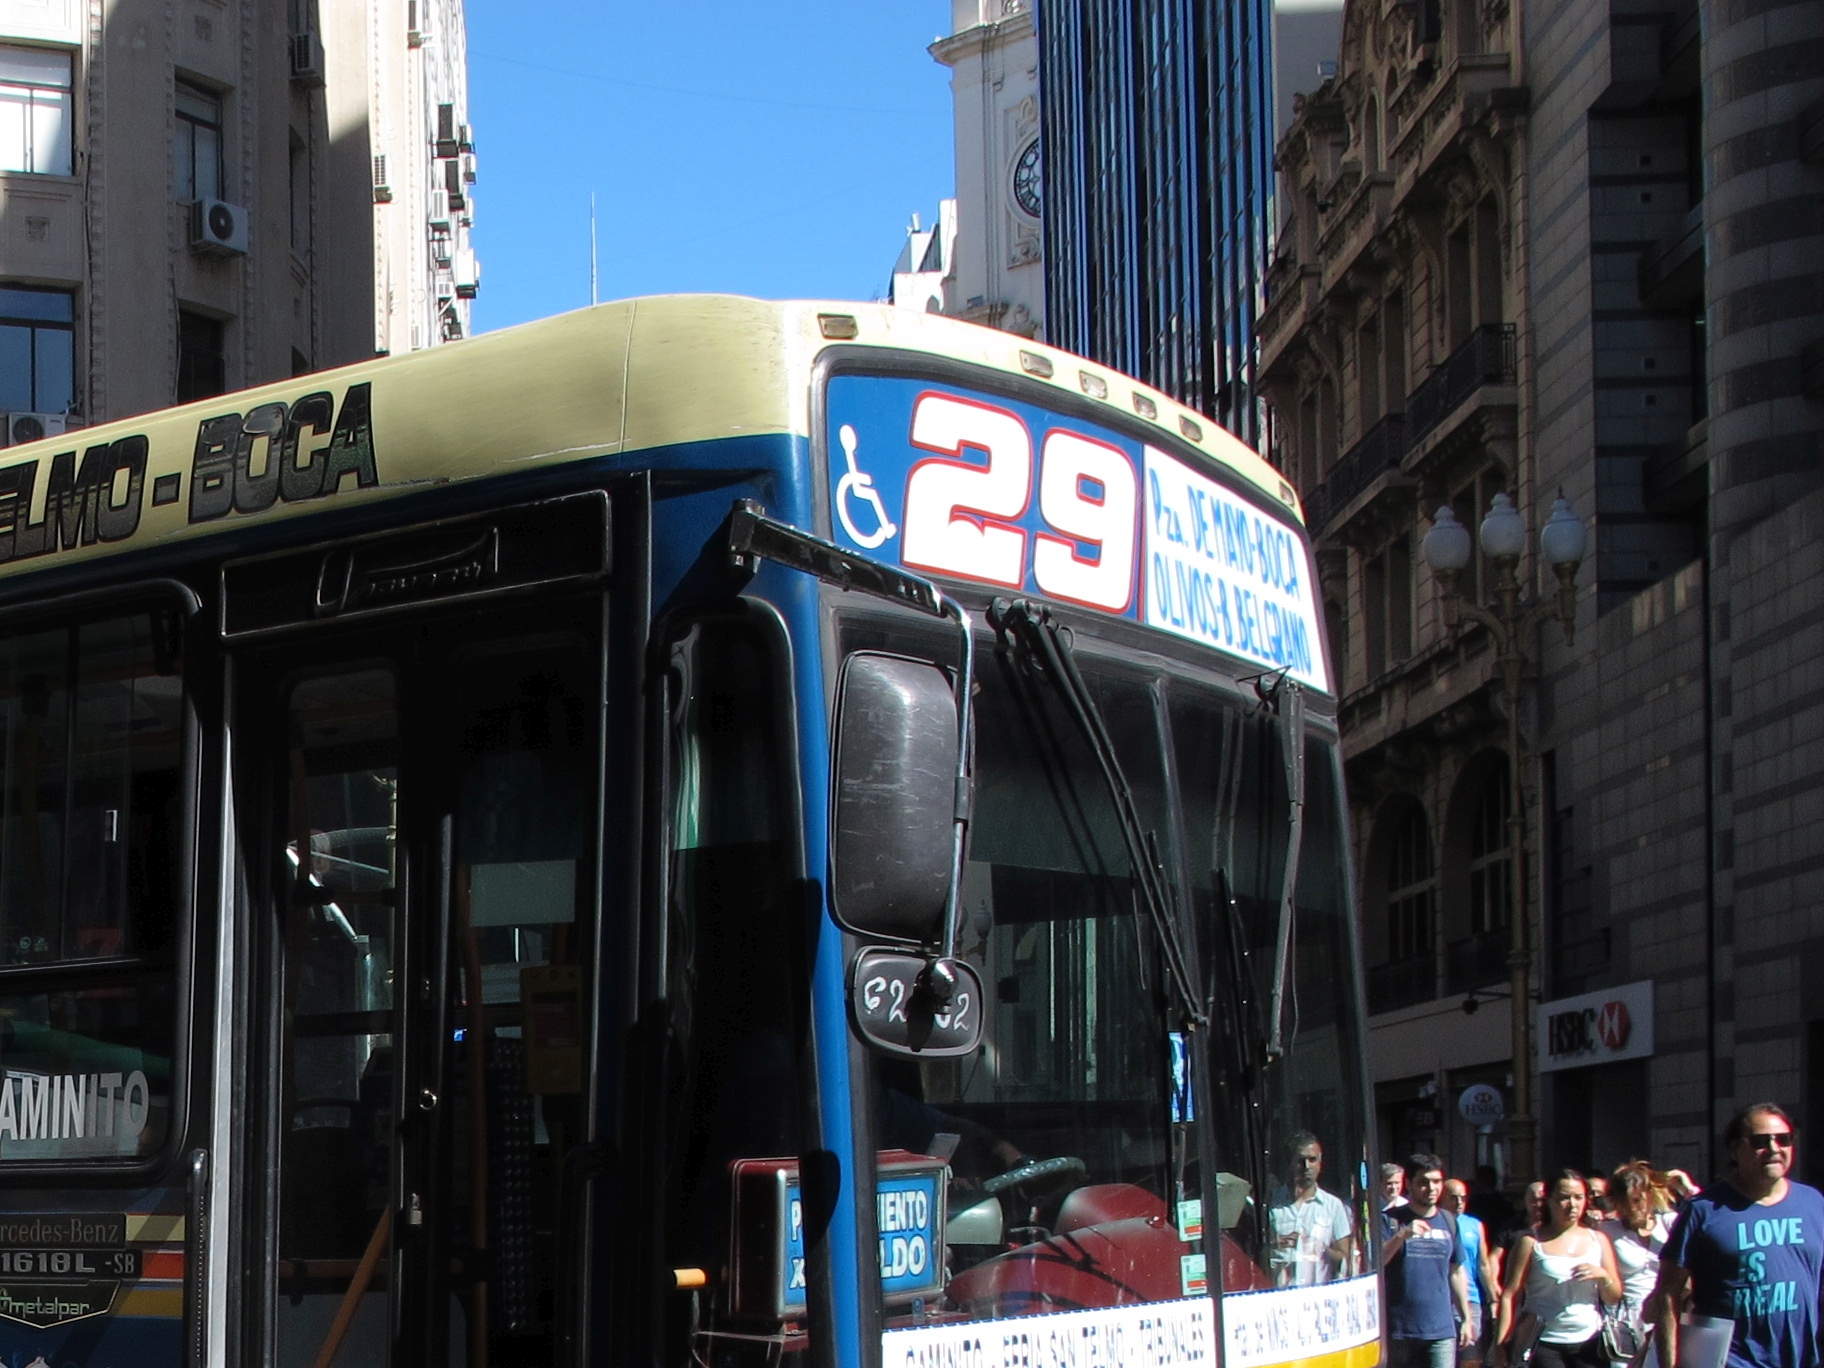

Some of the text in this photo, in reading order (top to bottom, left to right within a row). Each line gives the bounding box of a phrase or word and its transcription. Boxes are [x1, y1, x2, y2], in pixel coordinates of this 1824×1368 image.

[187, 380, 380, 525] BOCA
[901, 389, 1137, 615] 29
[1187, 483, 1214, 558] DE
[1465, 1102, 1501, 1116] HSBC
[1738, 1217, 1805, 1251] LOVE
[1738, 1251, 1767, 1283] IS
[8, 1296, 92, 1321] metalpar
[1734, 1280, 1799, 1319] REAL
[1139, 1311, 1205, 1368] TRIBUNALES
